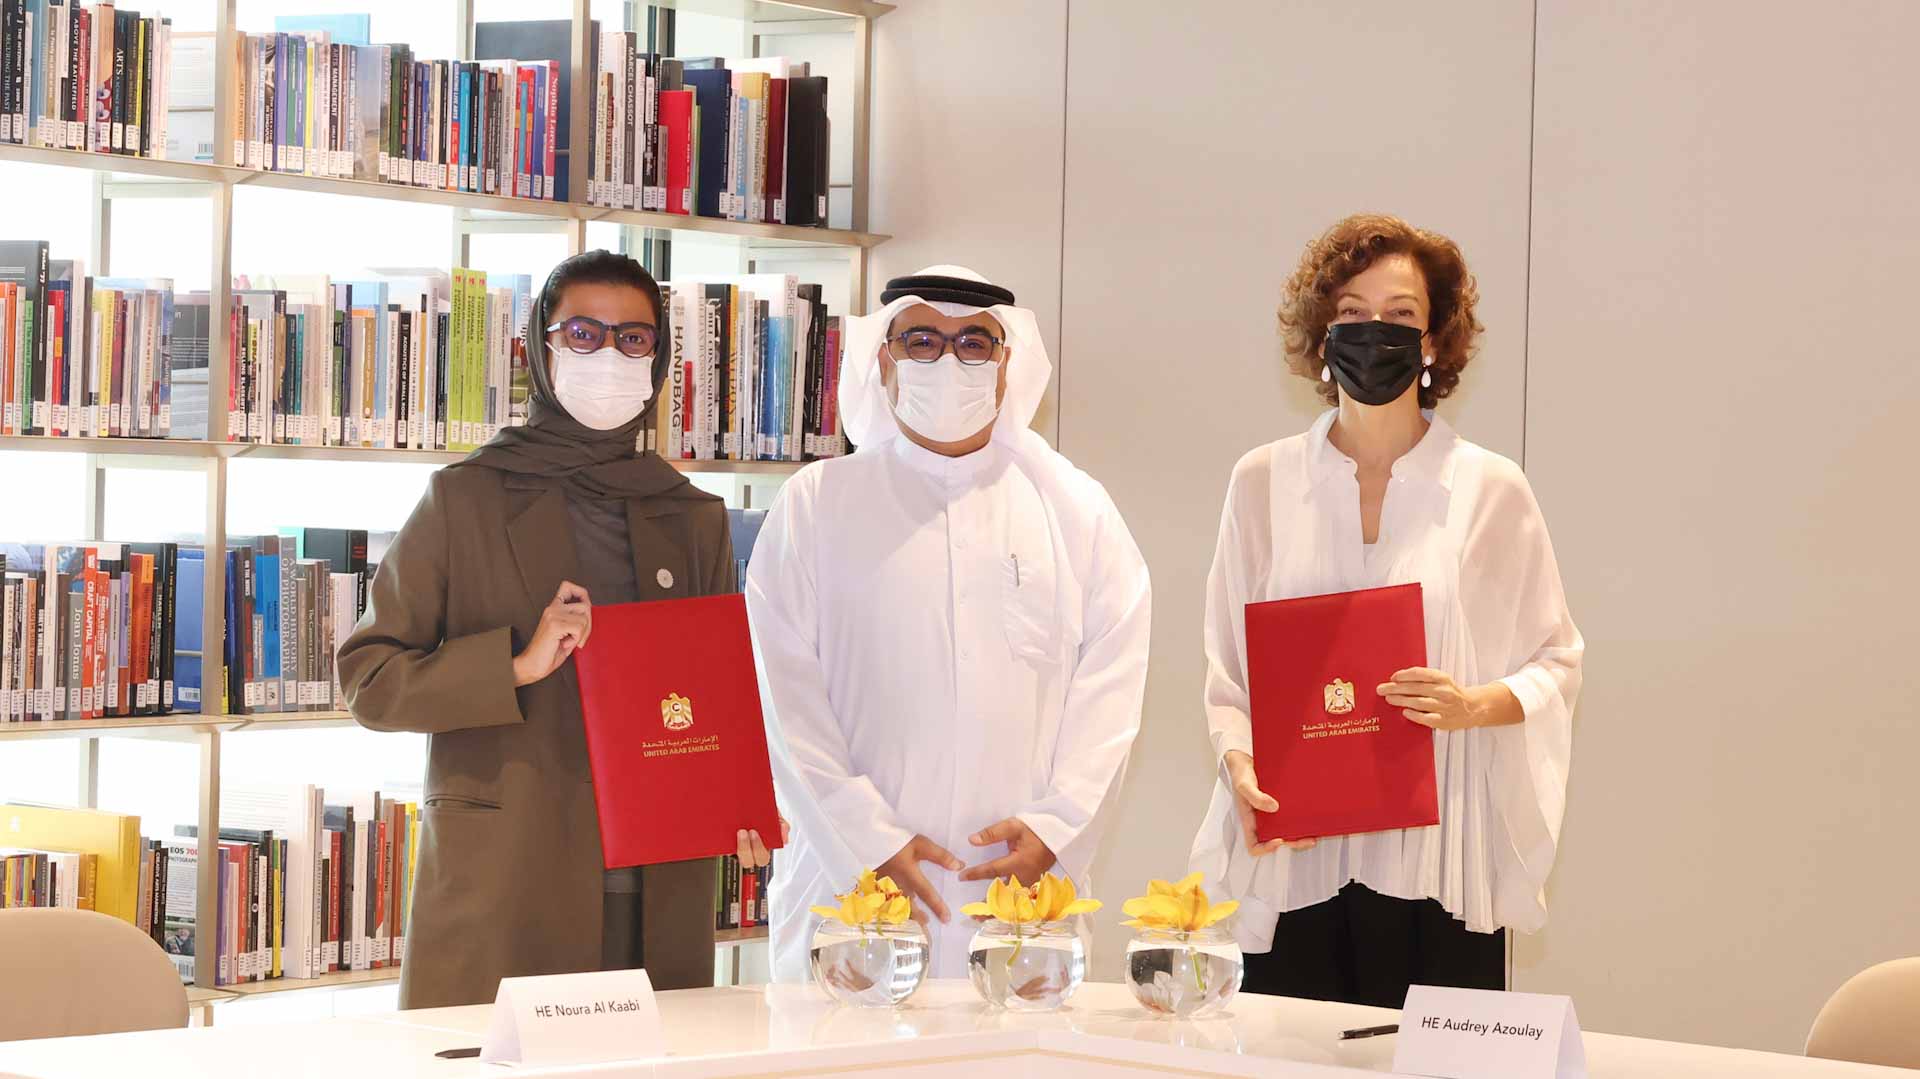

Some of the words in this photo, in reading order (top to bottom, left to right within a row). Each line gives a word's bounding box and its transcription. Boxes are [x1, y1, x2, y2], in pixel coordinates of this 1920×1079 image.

[115, 47, 124, 76] ARTS
[549, 77, 558, 117] Sophia
[626, 85, 634, 127] CHASSOT
[548, 120, 557, 153] Loren
[402, 371, 407, 380] OF
[672, 326, 683, 428] HANDBAG
[281, 558, 290, 573] OF
[290, 558, 296, 568] A
[86, 581, 94, 608] CRAFT
[73, 608, 82, 638] Joan
[85, 610, 94, 642] CAPITAL
[281, 580, 290, 673] PHOTOGRAPHY
[72, 642, 81, 680] Jonas
[1302, 723, 1327, 731] المتحدة
[1303, 730, 1328, 739] UNITED
[1329, 727, 1347, 736] ARAB
[1347, 725, 1380, 735] EMIRATES
[1327, 720, 1353, 729] العربية
[642, 740, 667, 748] المتحدة
[643, 749, 669, 758] UNITED
[669, 747, 687, 755] ARAB
[688, 744, 720, 753] EMIRATES
[668, 738, 692, 747] العربية
[535, 1005, 553, 1018] HE
[555, 1004, 591, 1016] Noura
[594, 1001, 606, 1014] Al
[608, 999, 640, 1012] Kaabi
[1421, 1016, 1440, 1029] HE
[1443, 1018, 1489, 1036] Audrey
[1492, 1022, 1544, 1041] Azoulay
